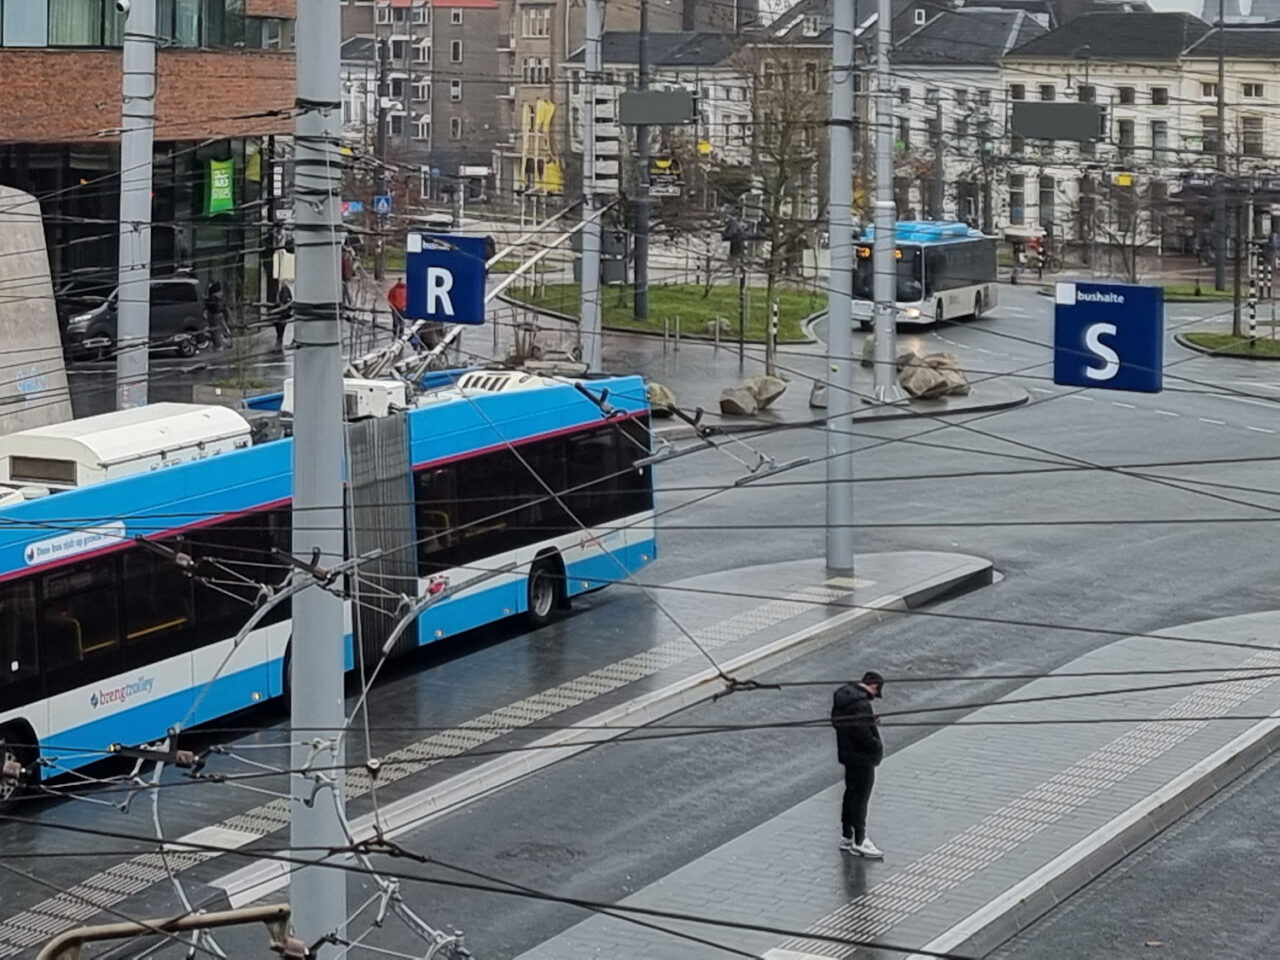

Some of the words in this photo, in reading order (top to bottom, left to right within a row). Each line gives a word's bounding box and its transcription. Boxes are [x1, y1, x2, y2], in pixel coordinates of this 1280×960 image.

[426, 266, 455, 316] R
[1077, 290, 1125, 304] bushalte
[1085, 322, 1120, 381] S
